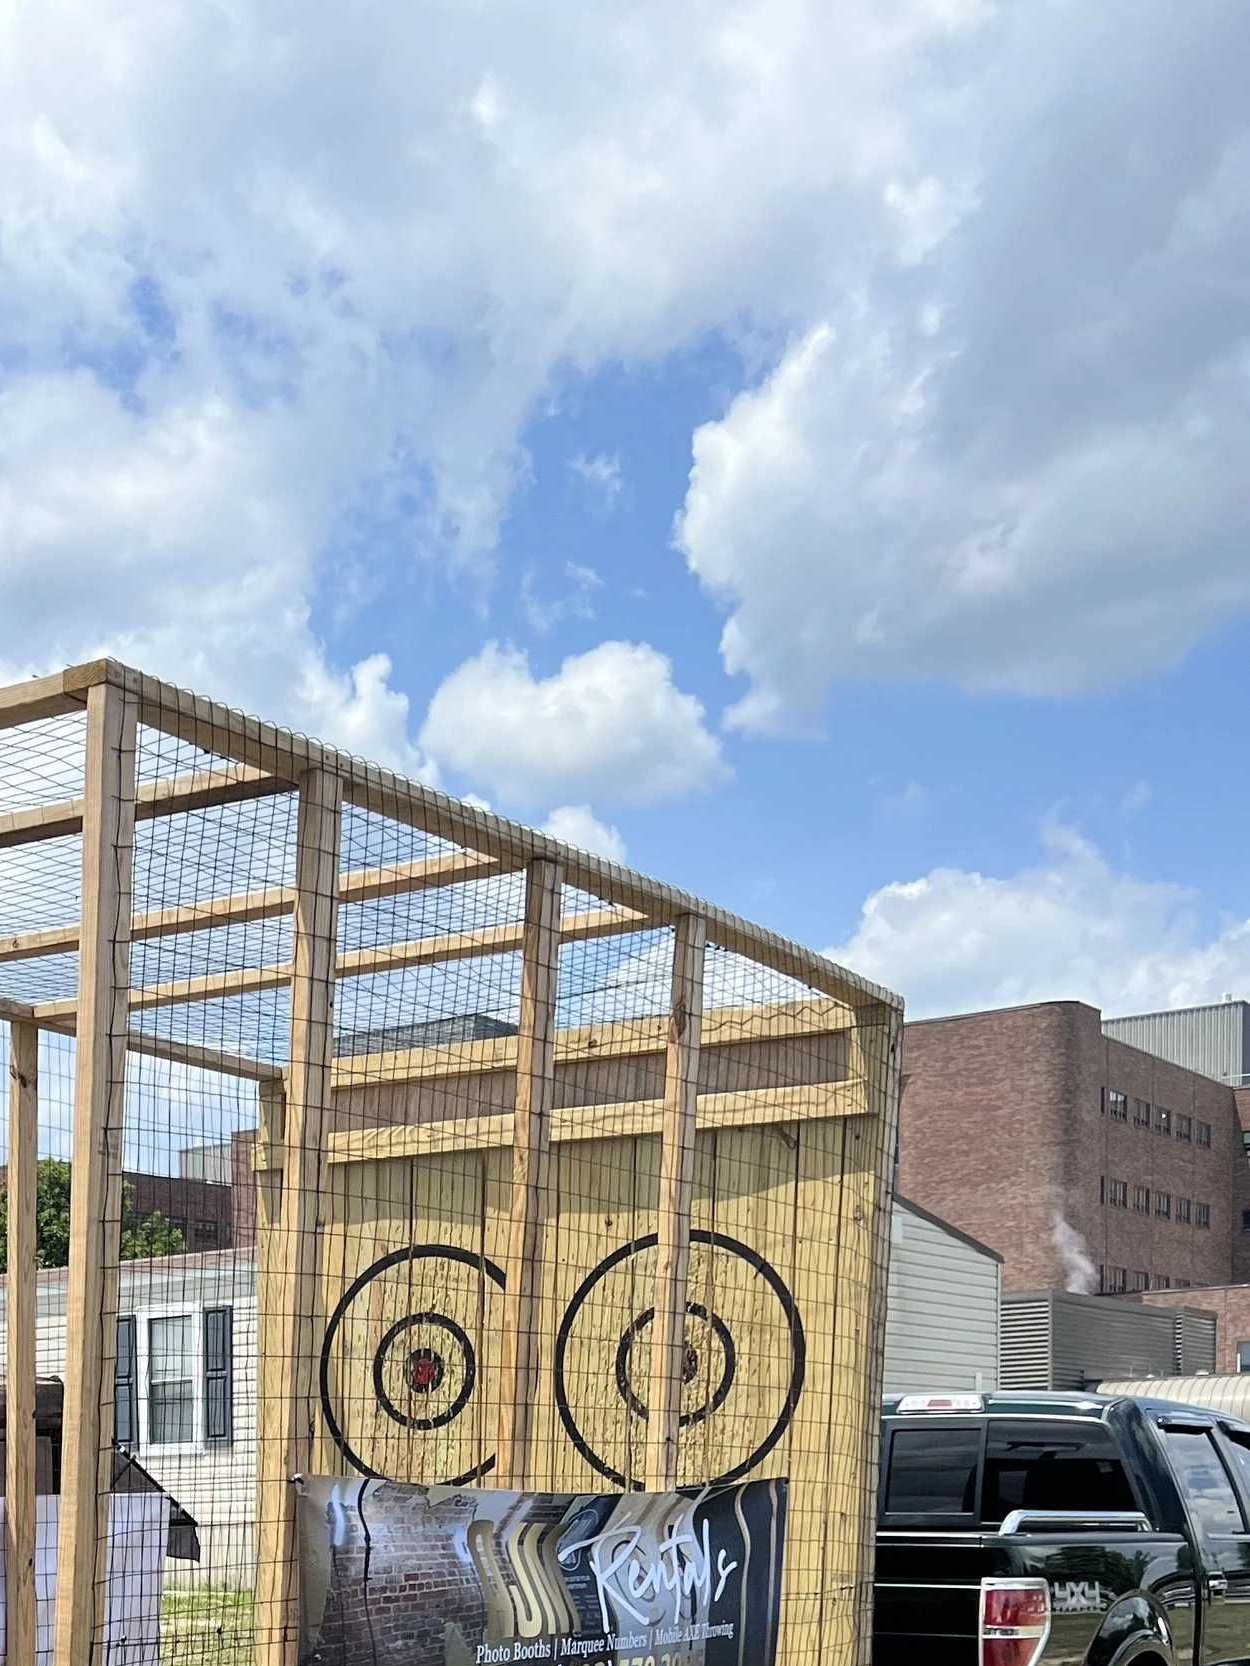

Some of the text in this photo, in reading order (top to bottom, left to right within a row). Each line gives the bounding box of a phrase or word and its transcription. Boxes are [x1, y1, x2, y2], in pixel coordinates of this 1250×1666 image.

[558, 1512, 737, 1634] Rentals
[475, 1619, 734, 1663] Photo Booths Marquee Numbers Mobile AXE Throwing
